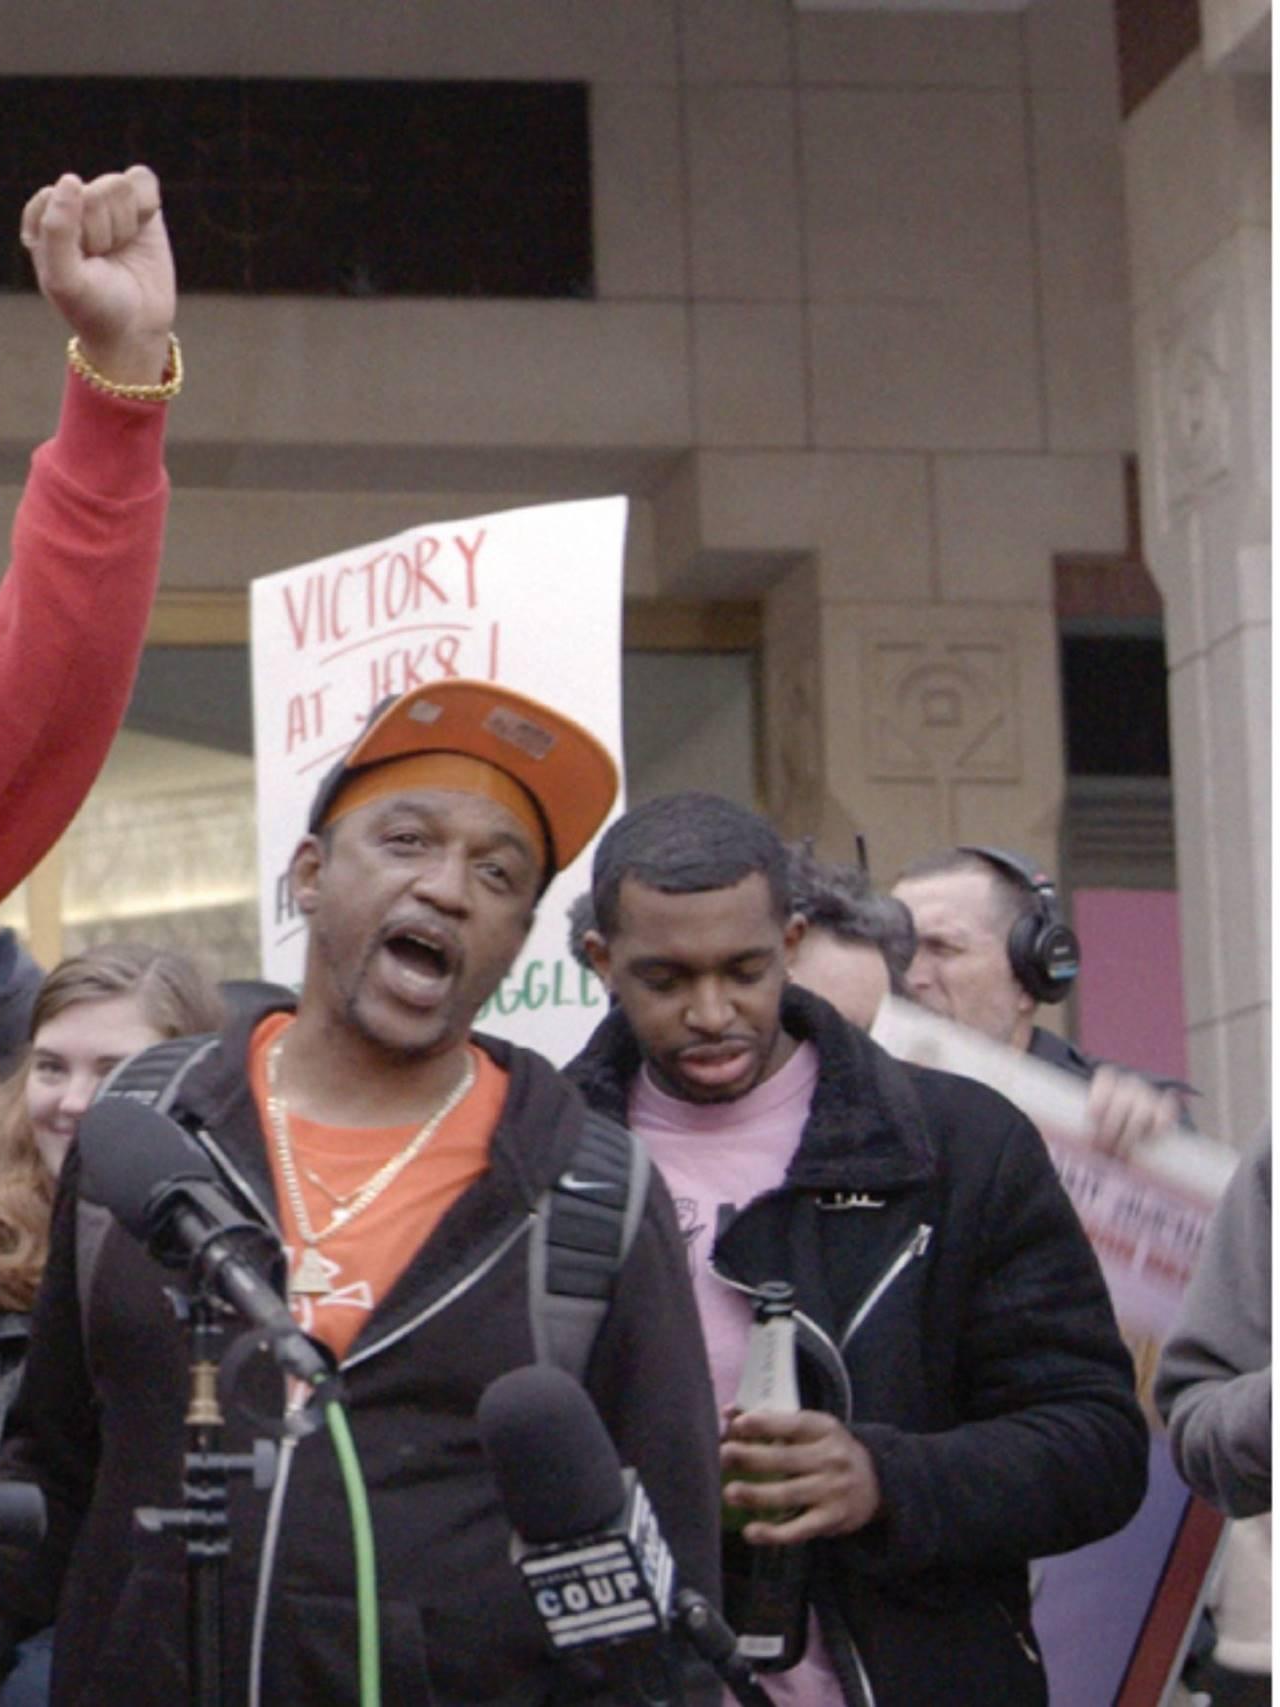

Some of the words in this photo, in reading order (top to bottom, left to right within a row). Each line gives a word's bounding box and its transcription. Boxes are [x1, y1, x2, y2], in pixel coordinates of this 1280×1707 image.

[282, 528, 487, 651] VICTORY
[286, 681, 332, 754] AT
[476, 958, 601, 1022] GGLE
[535, 1571, 640, 1617] COUP
